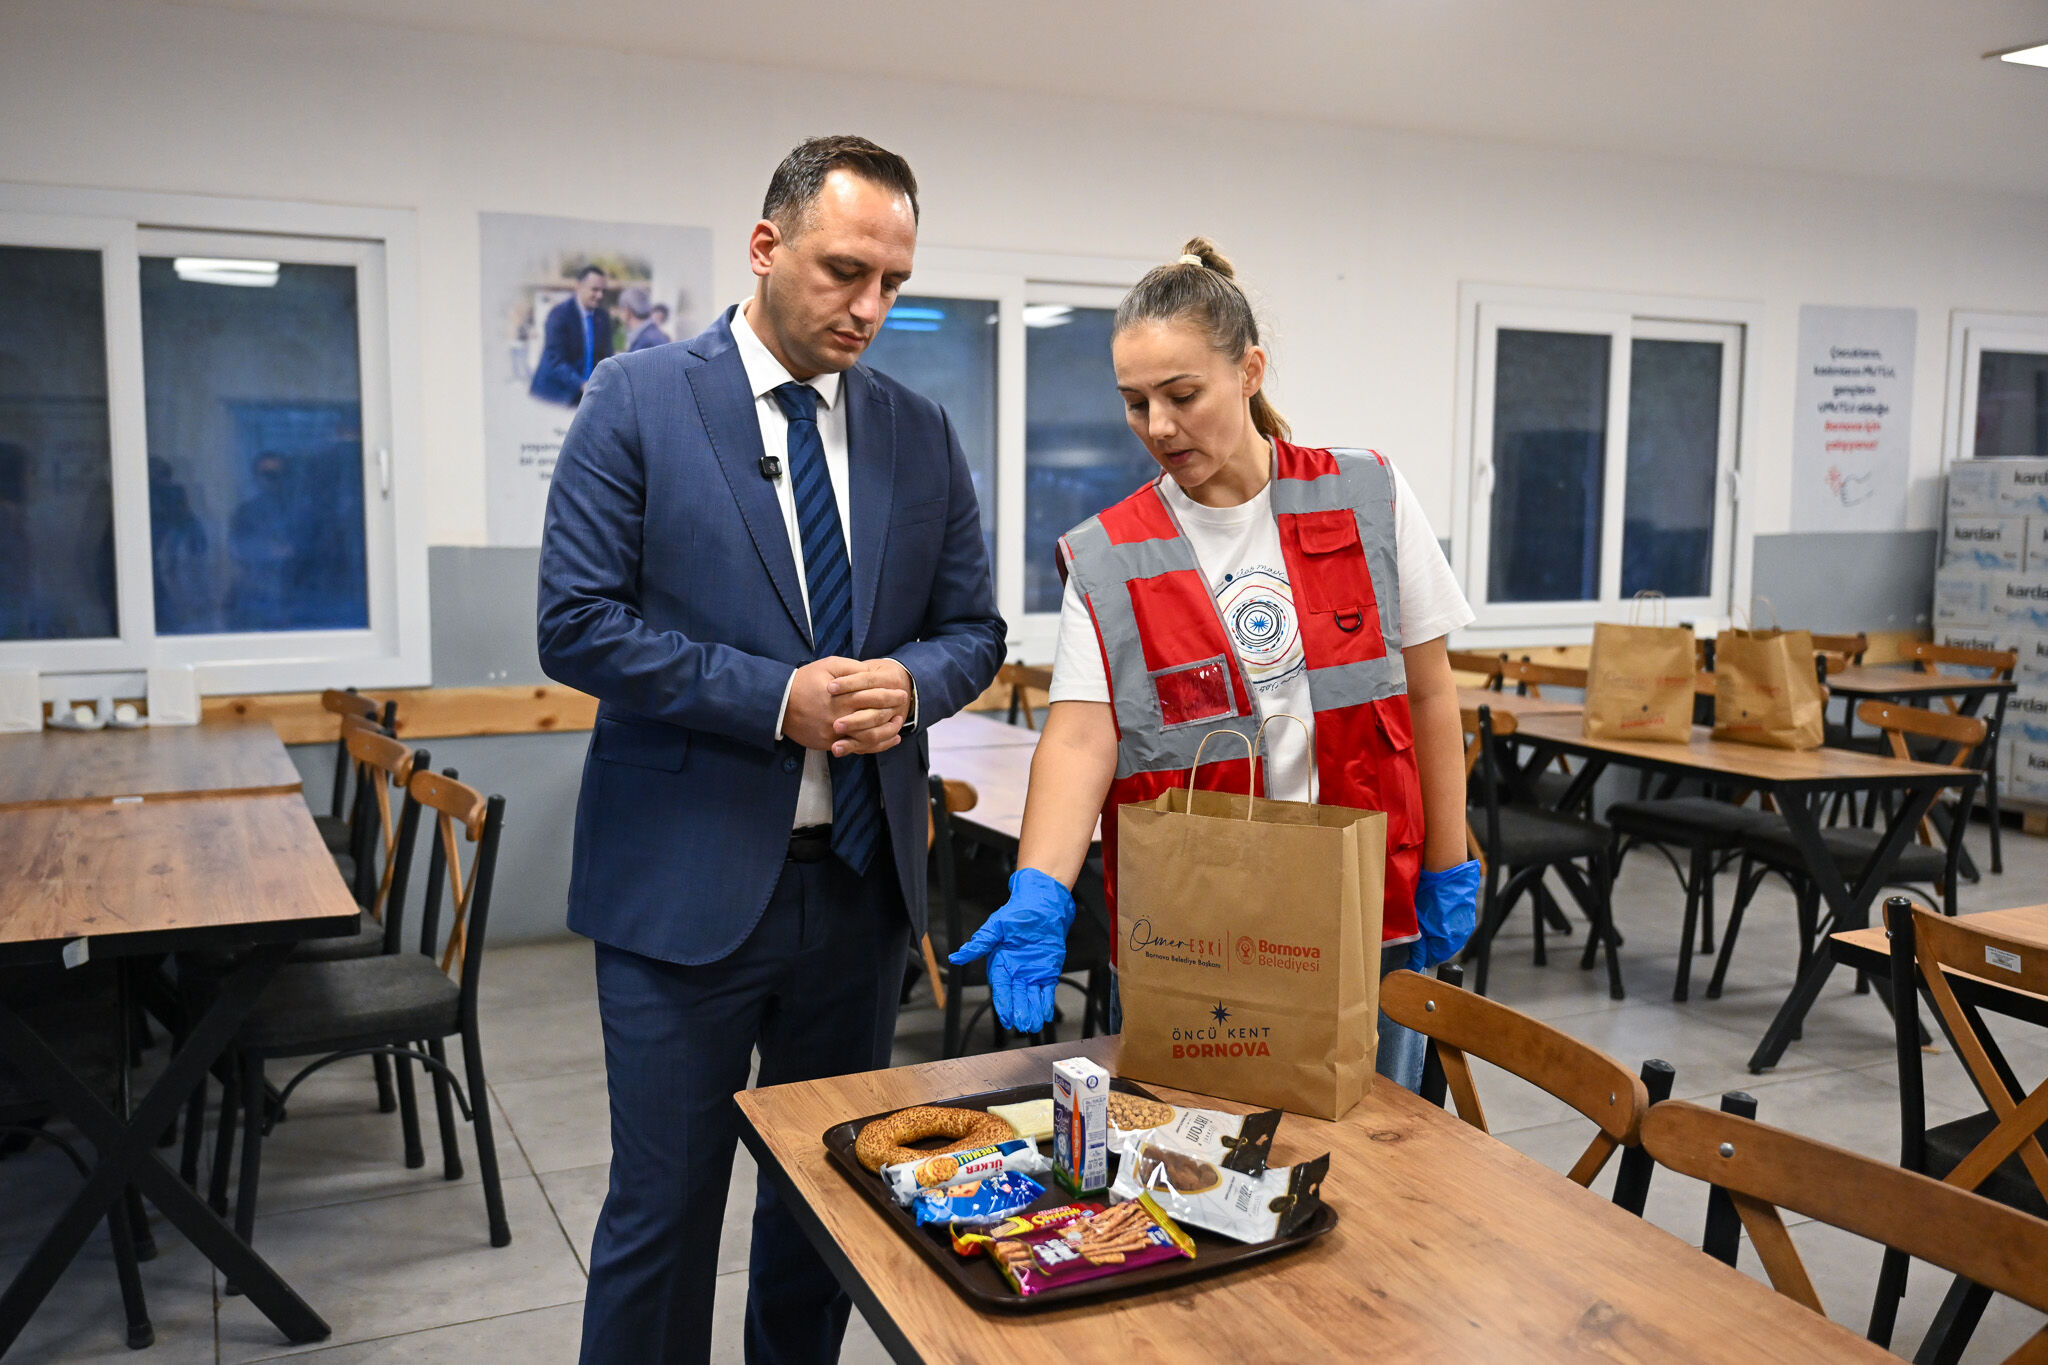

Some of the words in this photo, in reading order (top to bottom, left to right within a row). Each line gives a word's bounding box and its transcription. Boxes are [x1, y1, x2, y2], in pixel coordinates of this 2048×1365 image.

[1258, 939, 1321, 959] Bornova
[1145, 951, 1170, 961] Bornova
[1171, 954, 1196, 966] Belediye
[1258, 954, 1320, 974] Belediyesi
[1172, 1026, 1217, 1041] ÖNCÜ
[1227, 1027, 1270, 1039] KENT
[1172, 1041, 1270, 1059] BORNOVA
[957, 1145, 999, 1166] KREMALI
[965, 1159, 1003, 1175] ÜLKER
